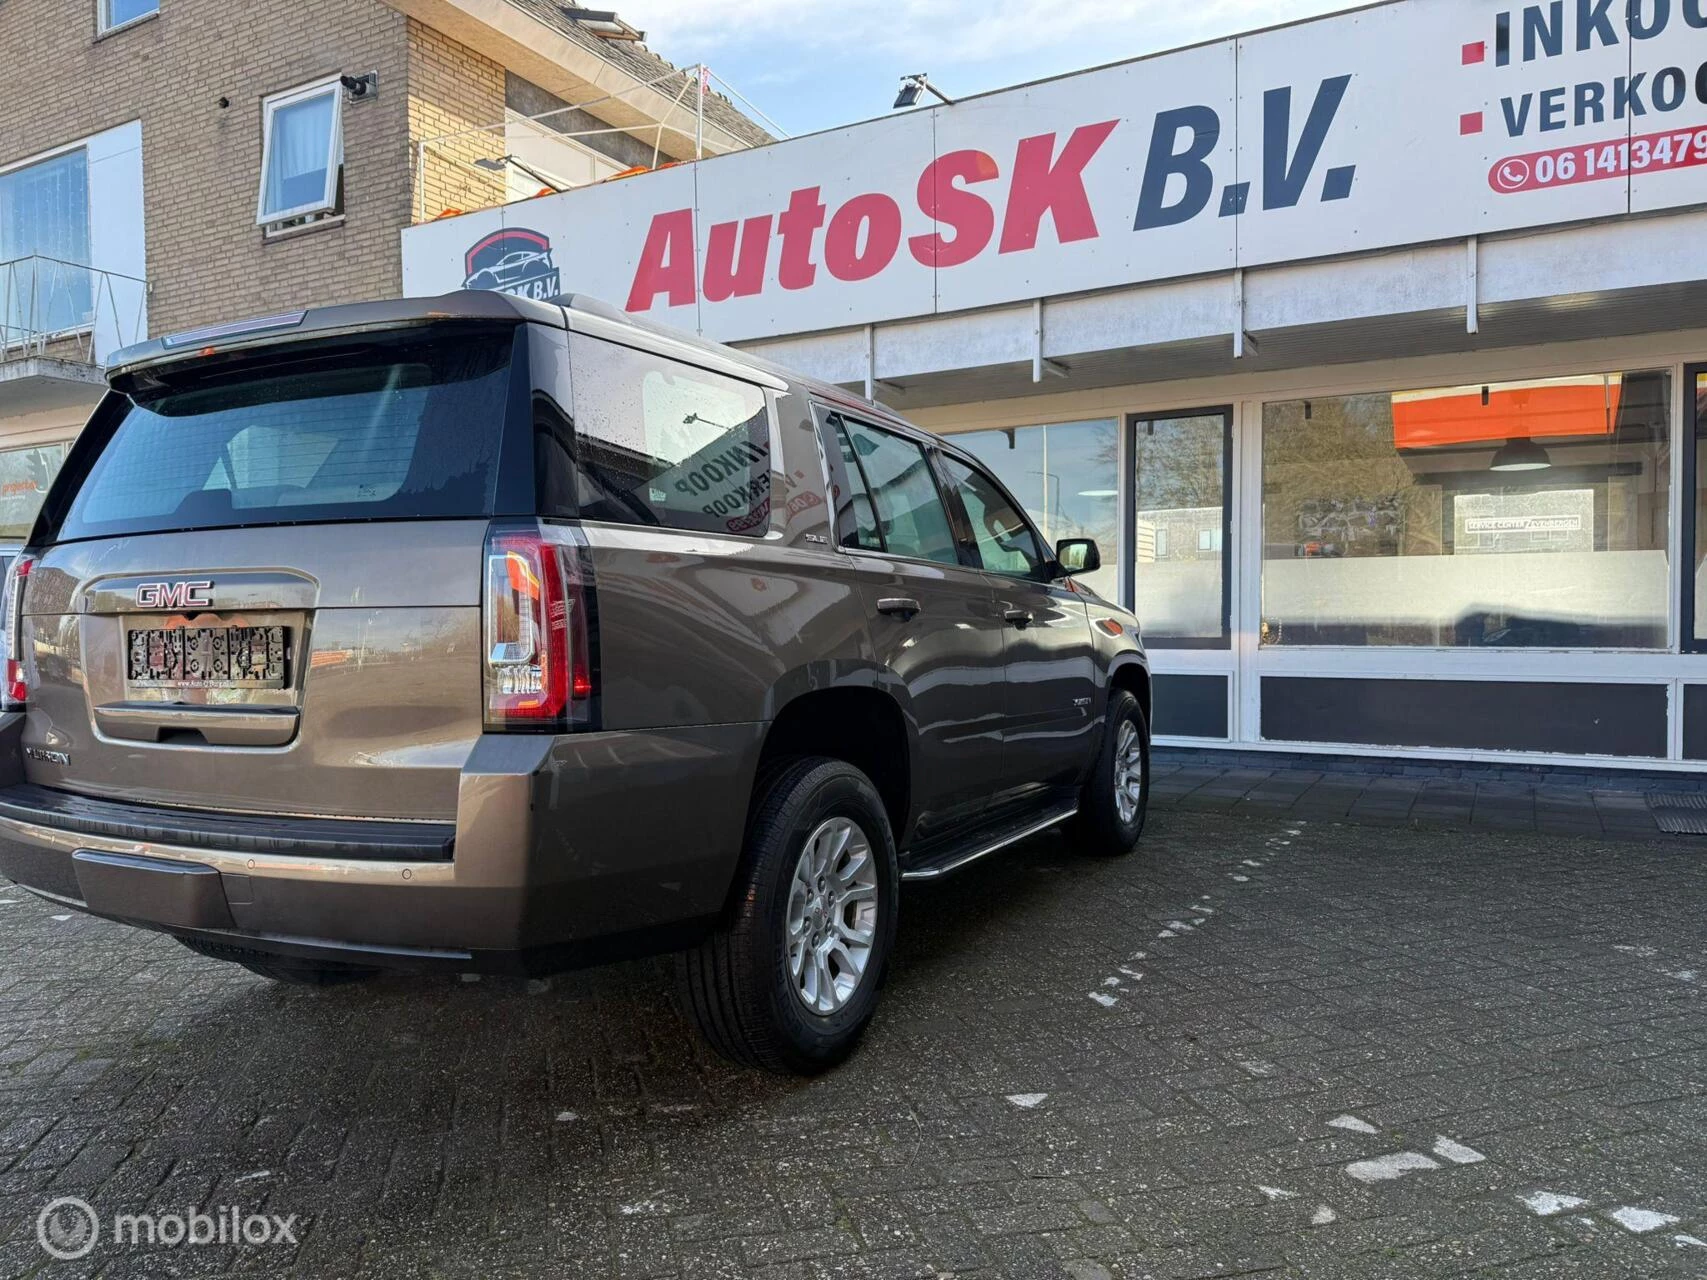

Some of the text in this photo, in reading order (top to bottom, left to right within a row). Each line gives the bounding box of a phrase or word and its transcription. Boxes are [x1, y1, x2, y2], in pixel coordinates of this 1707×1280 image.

[1535, 152, 1576, 183] 06
[625, 74, 1357, 313] AutoSK B.V.
[136, 581, 213, 608] GMC
